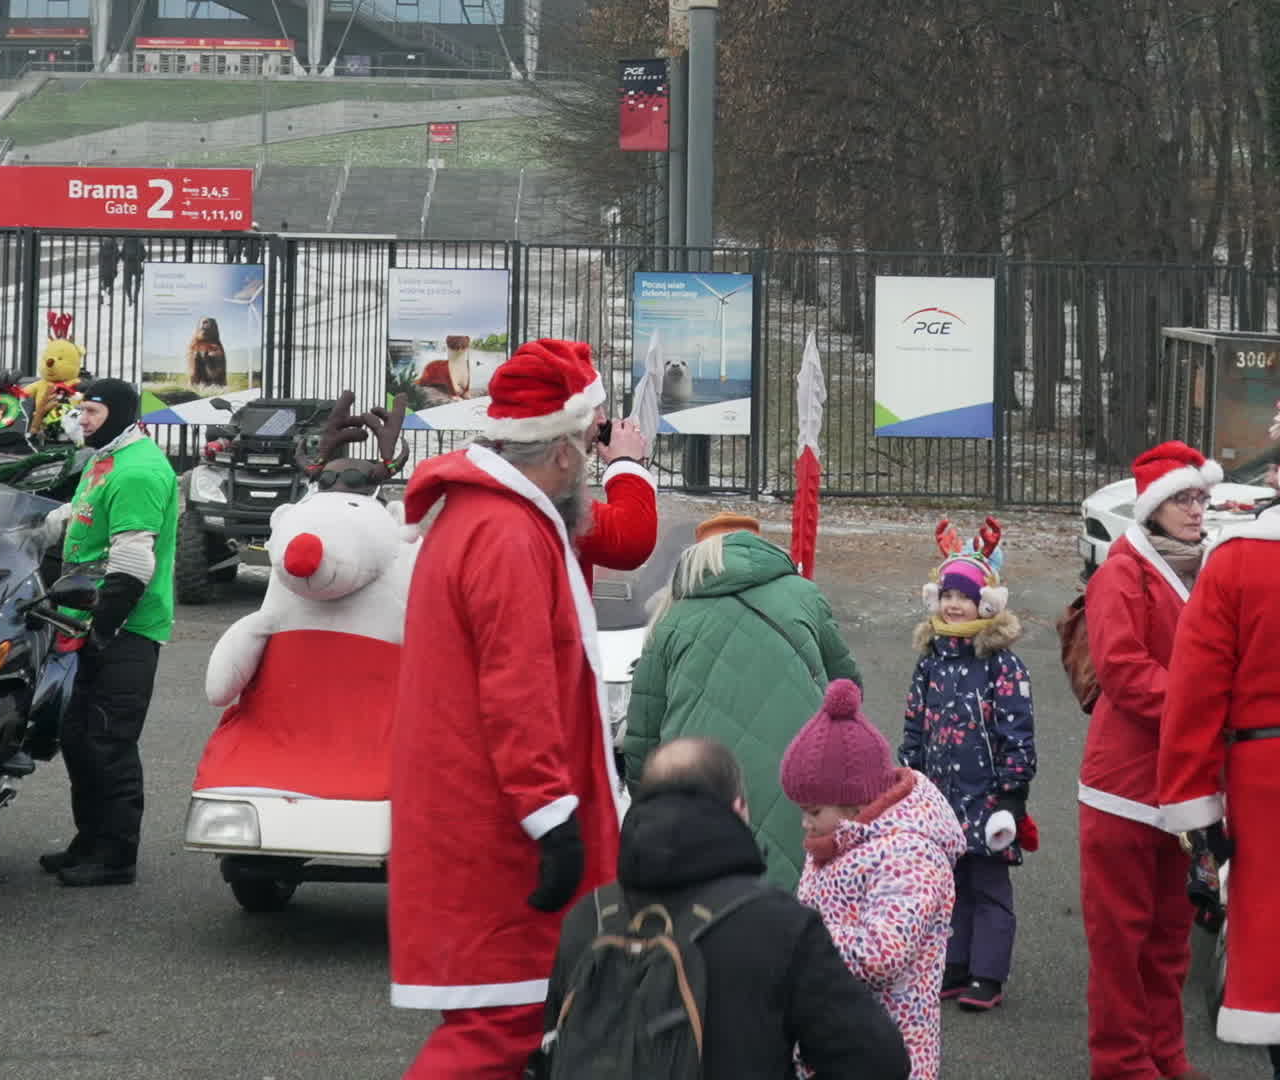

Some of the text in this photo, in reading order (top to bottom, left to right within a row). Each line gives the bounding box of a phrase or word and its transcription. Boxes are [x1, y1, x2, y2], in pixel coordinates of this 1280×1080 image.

[624, 67, 645, 75] PGE
[68, 180, 138, 200] Brama
[201, 187, 230, 199] 3,4,5
[147, 178, 174, 219] 2
[105, 201, 137, 215] Gate
[201, 210, 243, 222] 1,11,10
[913, 321, 952, 335] PGE
